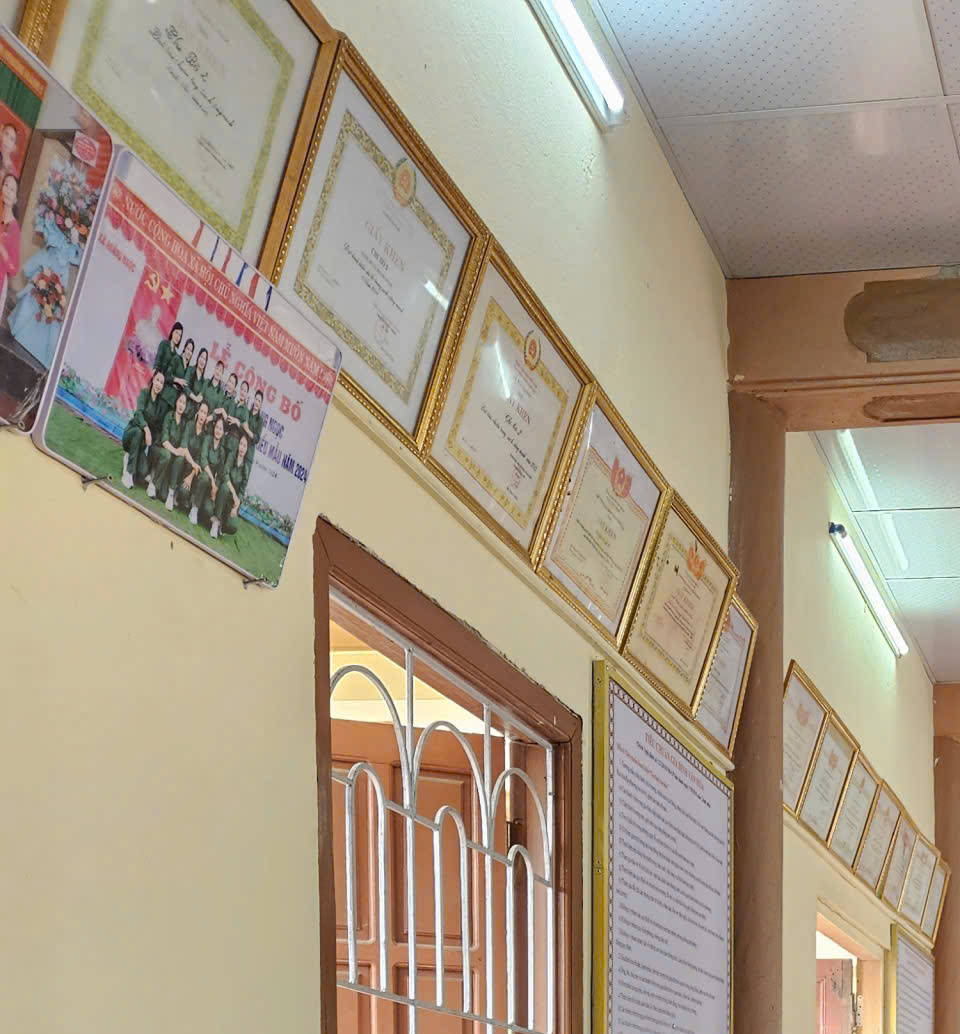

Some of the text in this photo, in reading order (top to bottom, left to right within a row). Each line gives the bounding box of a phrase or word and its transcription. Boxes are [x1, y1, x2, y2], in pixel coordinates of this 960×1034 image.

[147, 217, 171, 248] CỘNG
[199, 263, 214, 288] HỘI
[252, 308, 268, 333] VIỆT
[209, 341, 233, 369] LỄ
[233, 359, 278, 404] CÔNG
[279, 395, 304, 423] BỐ
[281, 451, 296, 474] NĂM
